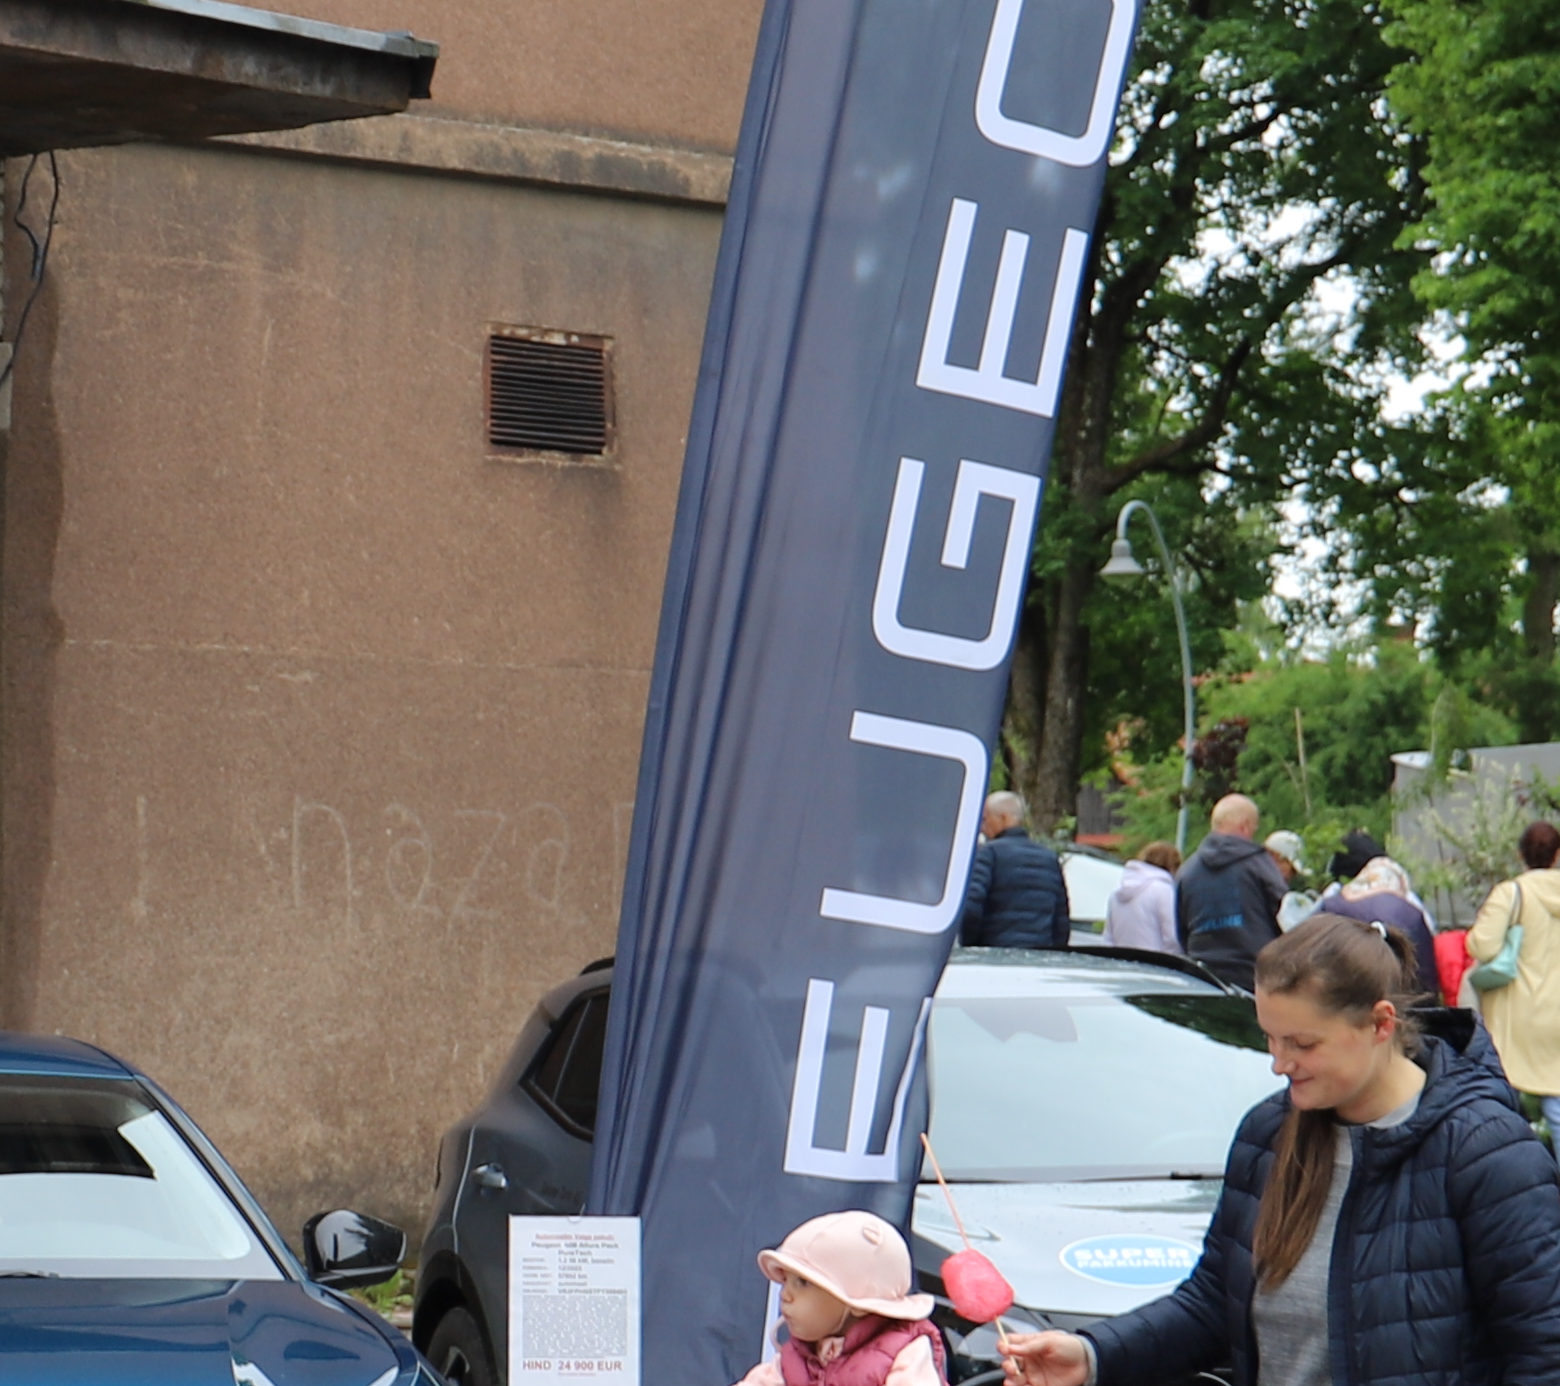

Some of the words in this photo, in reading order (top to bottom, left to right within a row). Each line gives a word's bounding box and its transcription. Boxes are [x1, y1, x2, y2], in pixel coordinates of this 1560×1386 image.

[1074, 1247, 1189, 1261] SUPER
[522, 1360, 552, 1370] HIND
[558, 1360, 571, 1370] 24
[574, 1361, 594, 1371] 900
[597, 1361, 622, 1371] EUR
